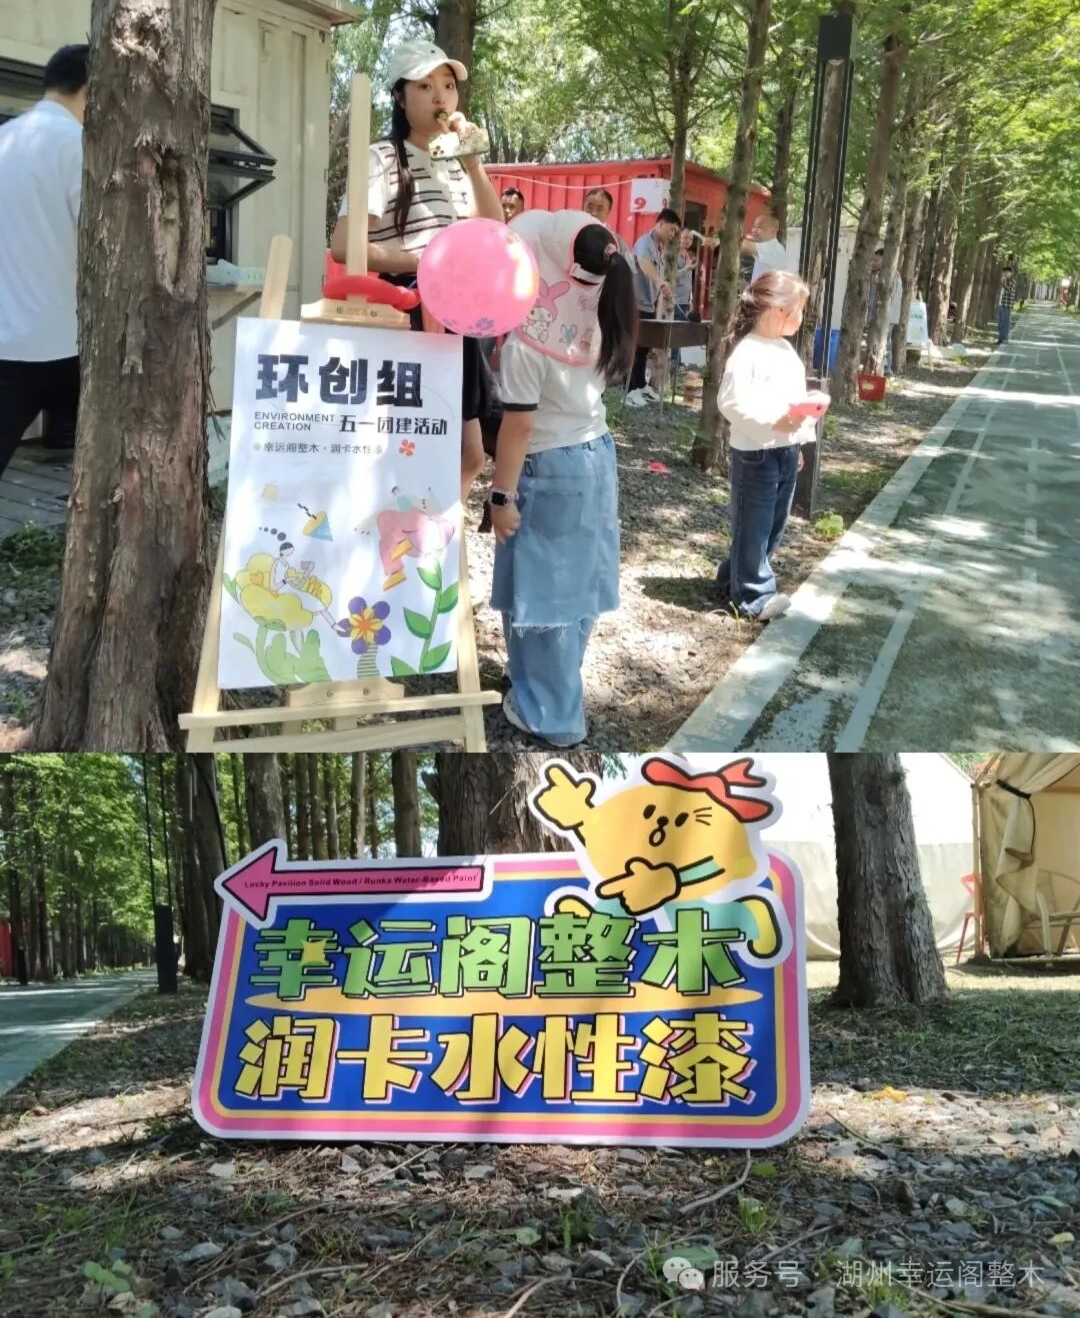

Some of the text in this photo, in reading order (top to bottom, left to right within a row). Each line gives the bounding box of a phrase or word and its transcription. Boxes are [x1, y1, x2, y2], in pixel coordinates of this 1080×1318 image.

[255, 353, 423, 408] 环创组
[254, 411, 335, 423] ENVIRONMENT
[254, 421, 311, 431] CREATION
[339, 413, 448, 435] 五一团建活动
[271, 879, 307, 888] Pavilion
[308, 878, 331, 886] Solid
[332, 877, 358, 885] Wood
[452, 874, 478, 882] Paint
[250, 908, 745, 999] 幸运阁整木
[234, 1012, 752, 1104] 润卡水性漆
